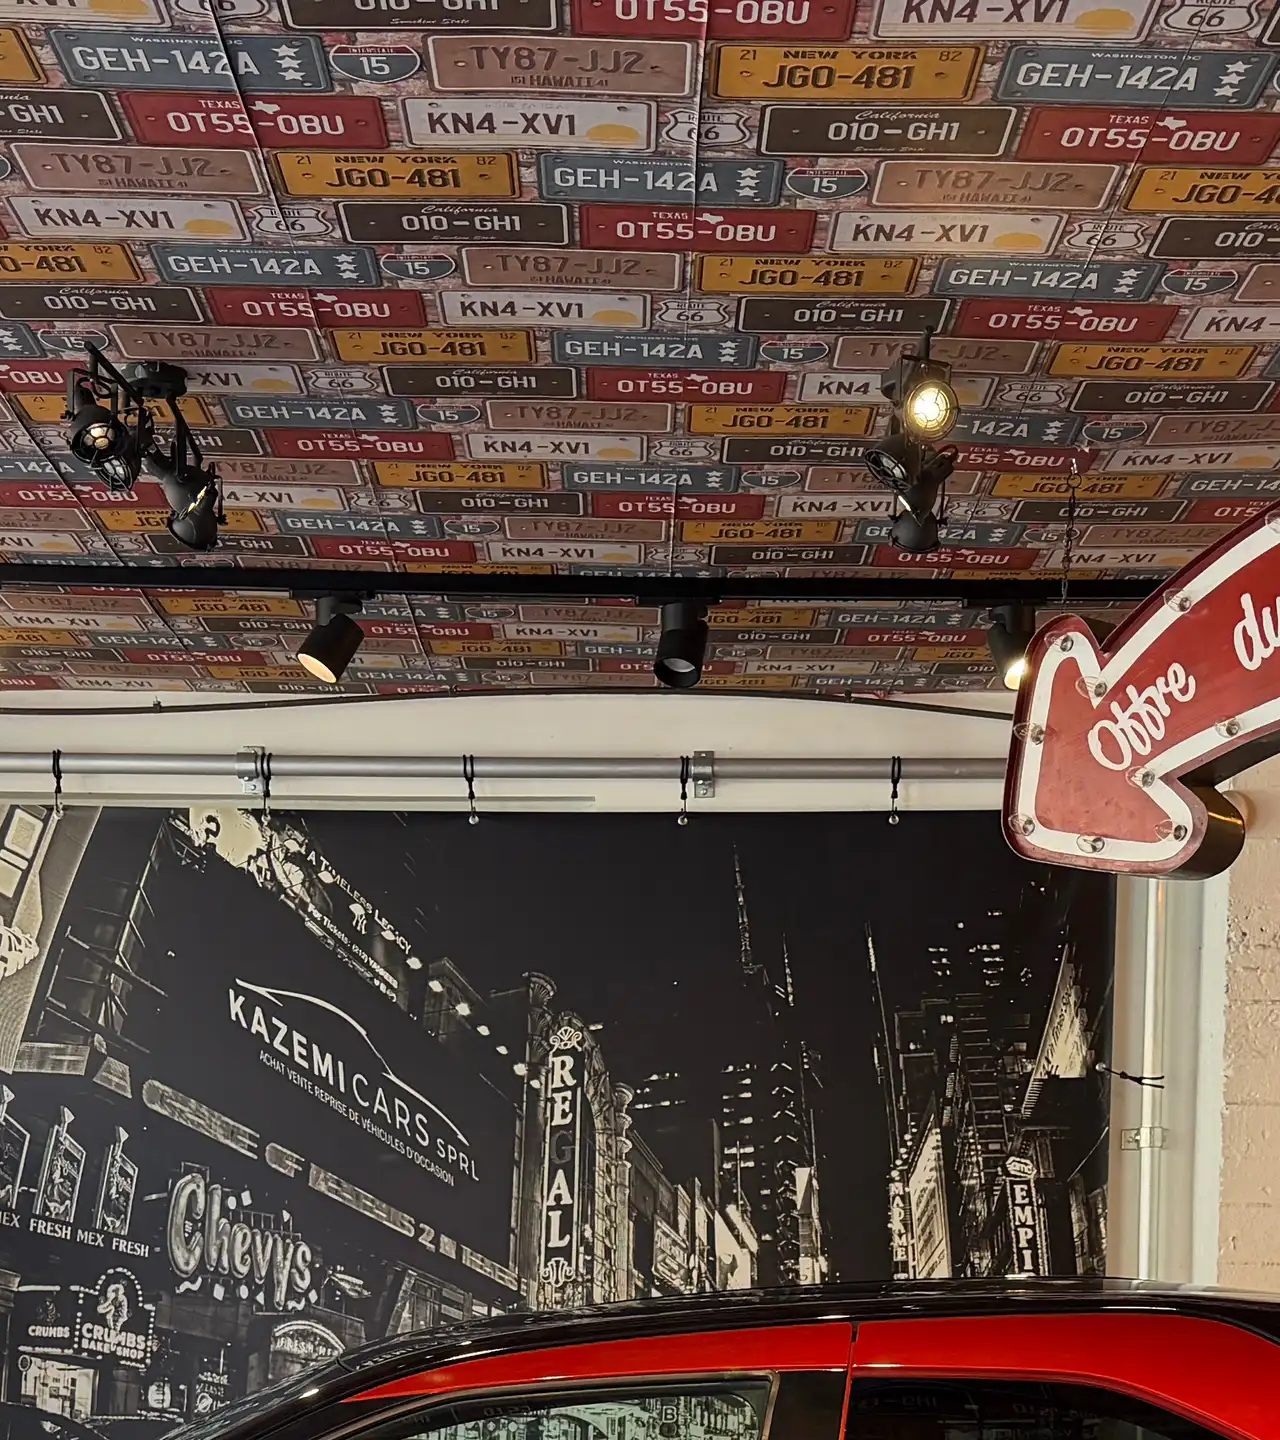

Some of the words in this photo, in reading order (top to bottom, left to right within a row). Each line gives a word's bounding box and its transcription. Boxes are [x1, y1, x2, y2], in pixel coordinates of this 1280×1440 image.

[1187, 8, 1222, 27] 66
[72, 46, 261, 76] GEH-142A
[359, 57, 390, 76] 15
[738, 49, 759, 61] 21
[783, 49, 841, 60] NEW
[850, 49, 919, 60] YORK
[939, 49, 963, 62] 82
[1091, 51, 1178, 61] WASHINGTON
[762, 65, 914, 90] JGO-481
[1017, 62, 1199, 91] GEH-142A
[854, 108, 942, 121] California
[1108, 114, 1150, 125] TEXAS
[554, 168, 719, 193] GEH-142A
[166, 255, 323, 276] GEH-142A
[573, 471, 694, 487] GEH-142A
[1087, 660, 1196, 772] Offre
[307, 850, 317, 866] A
[228, 988, 346, 1094] KAZEMI
[352, 1073, 431, 1148] CARS
[436, 1138, 480, 1182] SPRL
[259, 1049, 286, 1077] ACHAT
[287, 1065, 315, 1095] VENTE
[314, 1084, 349, 1118] REPRISE
[348, 1108, 361, 1126] DE
[361, 1115, 406, 1155] VÉHICULES
[406, 1146, 455, 1187] D'OCCASION
[546, 1054, 578, 1249] REGAL
[29, 1218, 72, 1240] FRESH
[76, 1228, 105, 1248] MEX
[111, 1238, 151, 1258] FRESH
[167, 1173, 313, 1310] Chevys
[1013, 1183, 1036, 1275] EMPI
[27, 1324, 70, 1338] CRUMBS
[81, 1321, 146, 1350] CRUMBS
